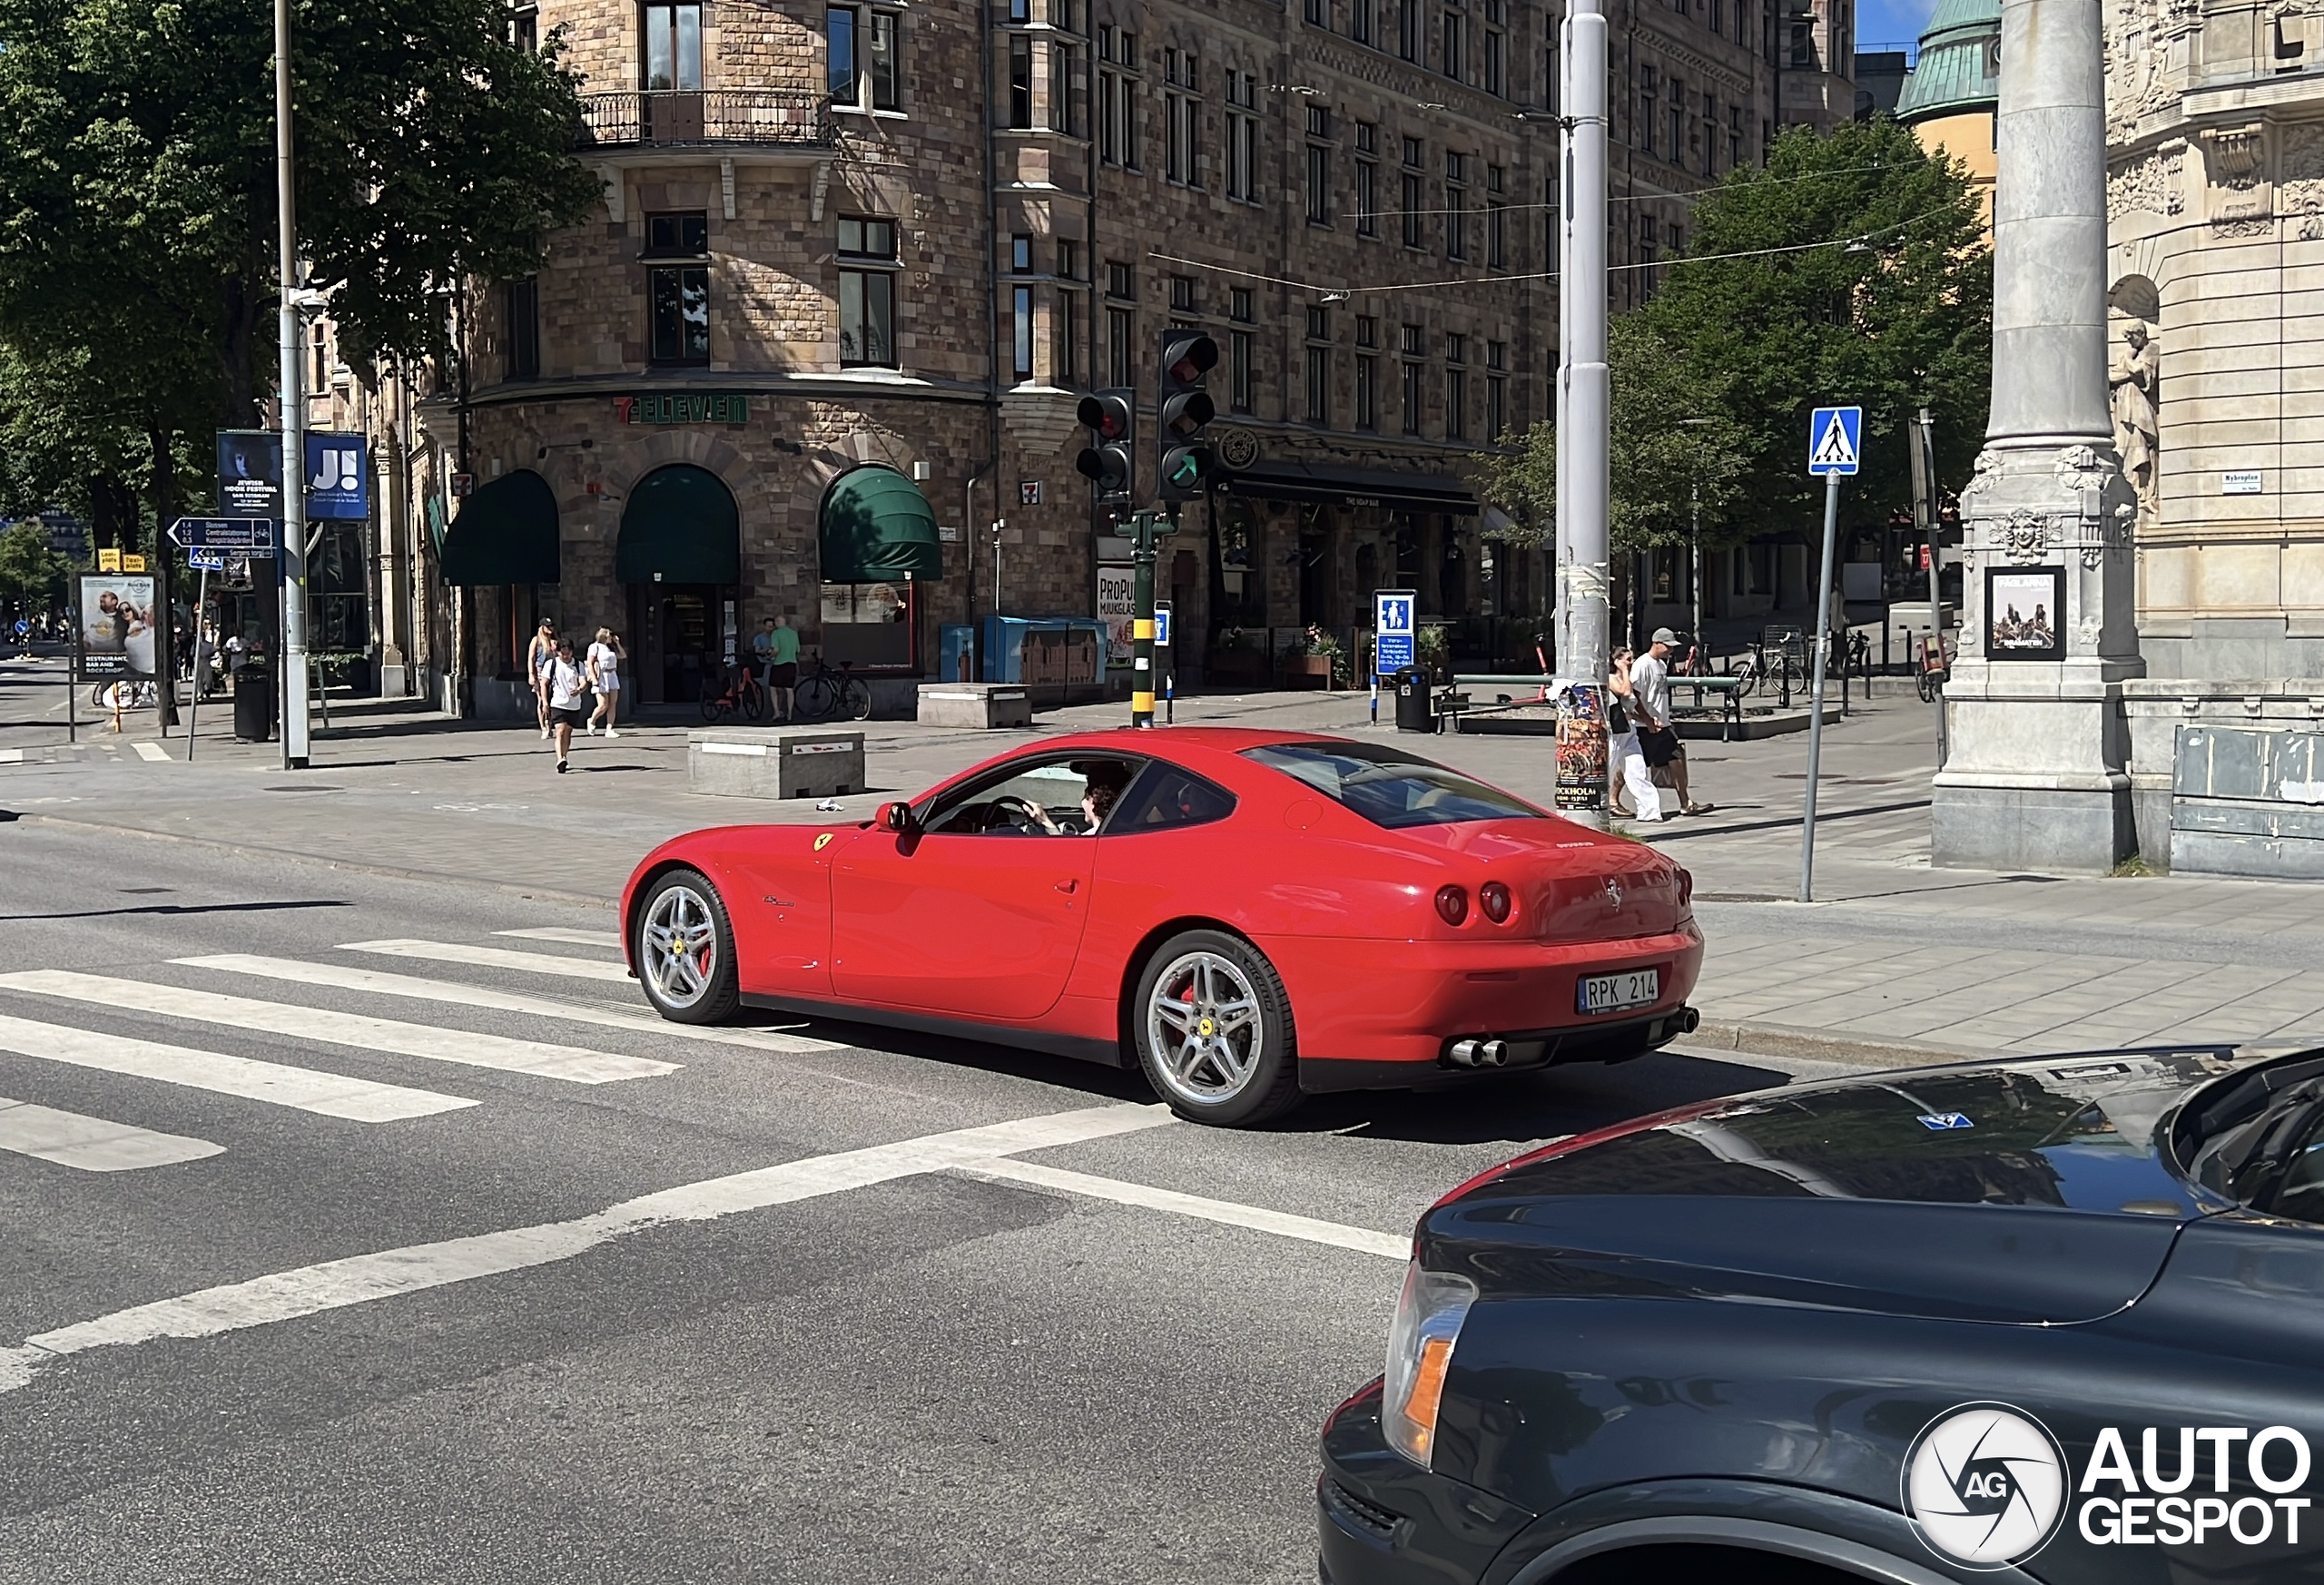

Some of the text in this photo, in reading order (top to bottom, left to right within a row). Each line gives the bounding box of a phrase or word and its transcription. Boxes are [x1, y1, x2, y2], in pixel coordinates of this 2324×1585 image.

[312, 449, 359, 490] J!
[1100, 603, 1136, 615] MJUKGLAS
[1589, 973, 1655, 1006] RPK 214
